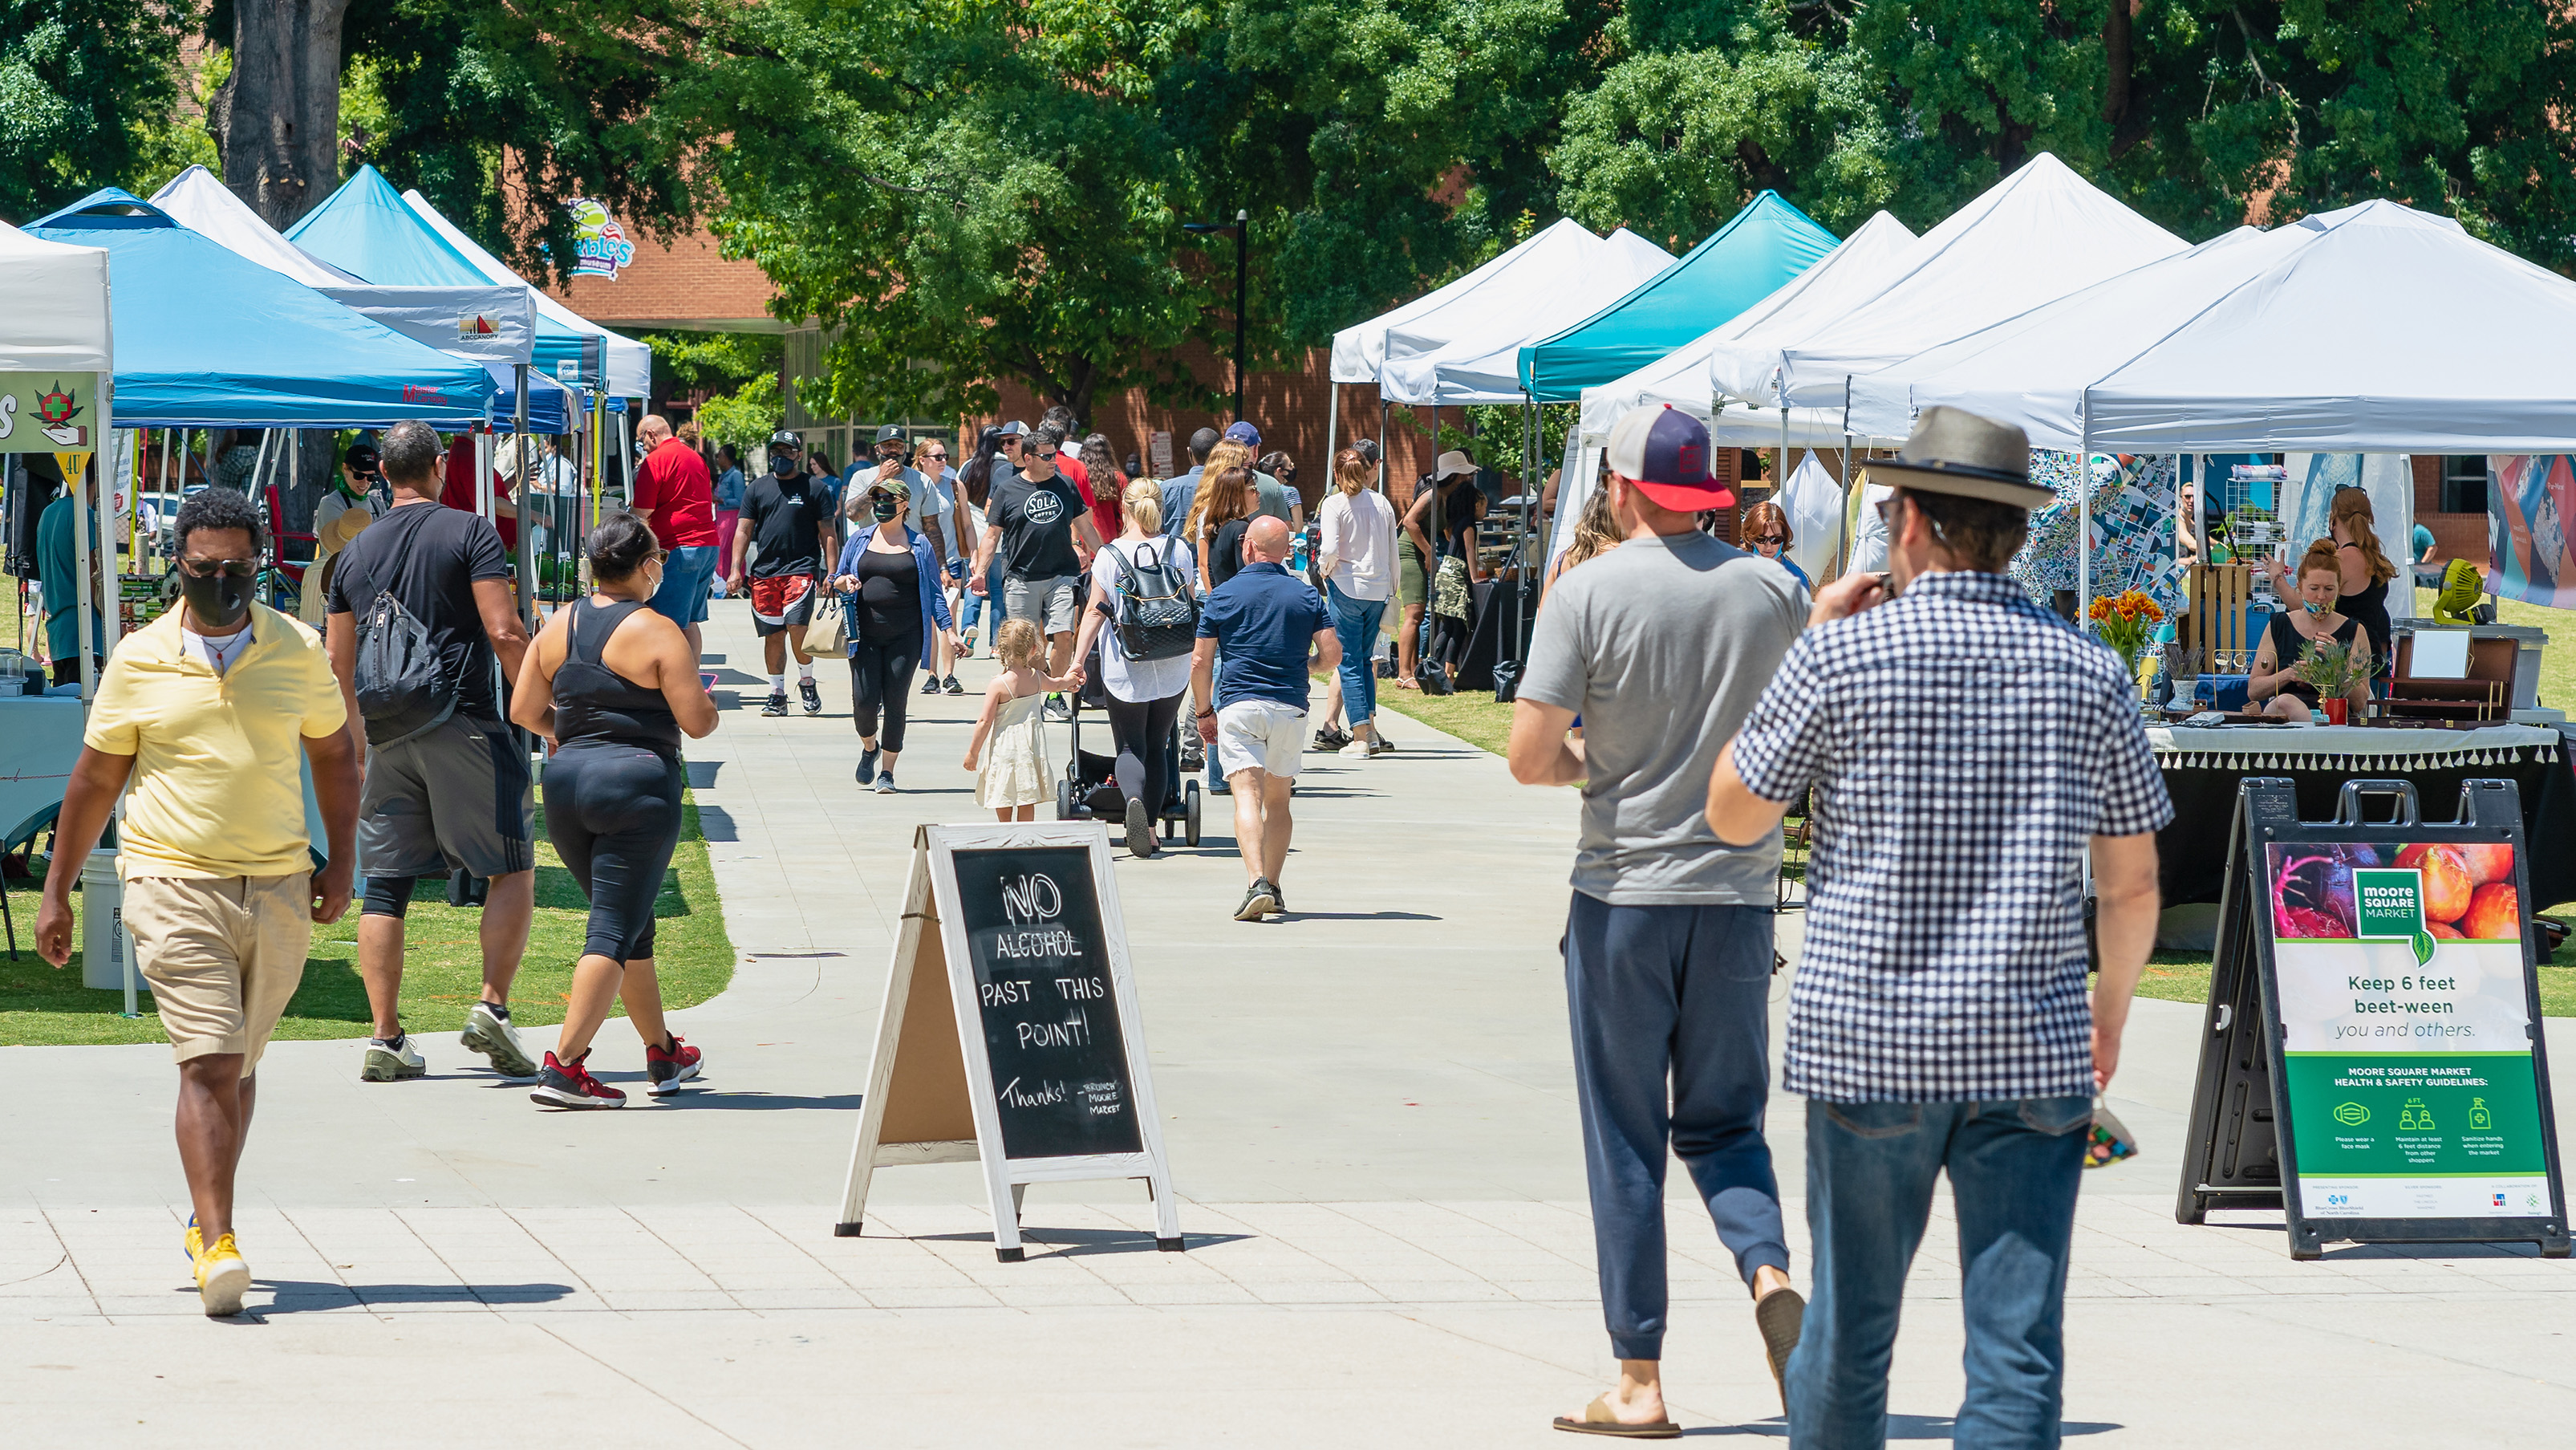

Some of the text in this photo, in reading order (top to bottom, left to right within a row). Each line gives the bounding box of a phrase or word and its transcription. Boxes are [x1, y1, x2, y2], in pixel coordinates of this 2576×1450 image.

[403, 384, 439, 402] Master
[416, 394, 448, 406] Canopy
[66, 454, 81, 474] 4U
[1028, 495, 1057, 514] SOLA
[1033, 510, 1056, 518] COFFEE
[1000, 873, 1062, 920] NO
[2363, 887, 2414, 897] moore
[2365, 898, 2415, 908] SQUARE
[2366, 909, 2415, 918] MARKET
[997, 930, 1082, 959] ALCOHOL
[981, 977, 1104, 1007] PAST THIS
[2348, 976, 2456, 993] Keep 6 feet
[2355, 999, 2453, 1013] beet-ween
[1016, 1006, 1090, 1050] POINT!
[2335, 1022, 2476, 1039] you and others.
[2348, 1067, 2472, 1075] MOORE SQUARE MARKET
[2335, 1078, 2488, 1086] HEALTH & SAFETY GUIDELINES:
[1000, 1076, 1069, 1108] Thanks!
[1088, 1091, 1118, 1103] MOORE
[1089, 1103, 1121, 1115] MARKET
